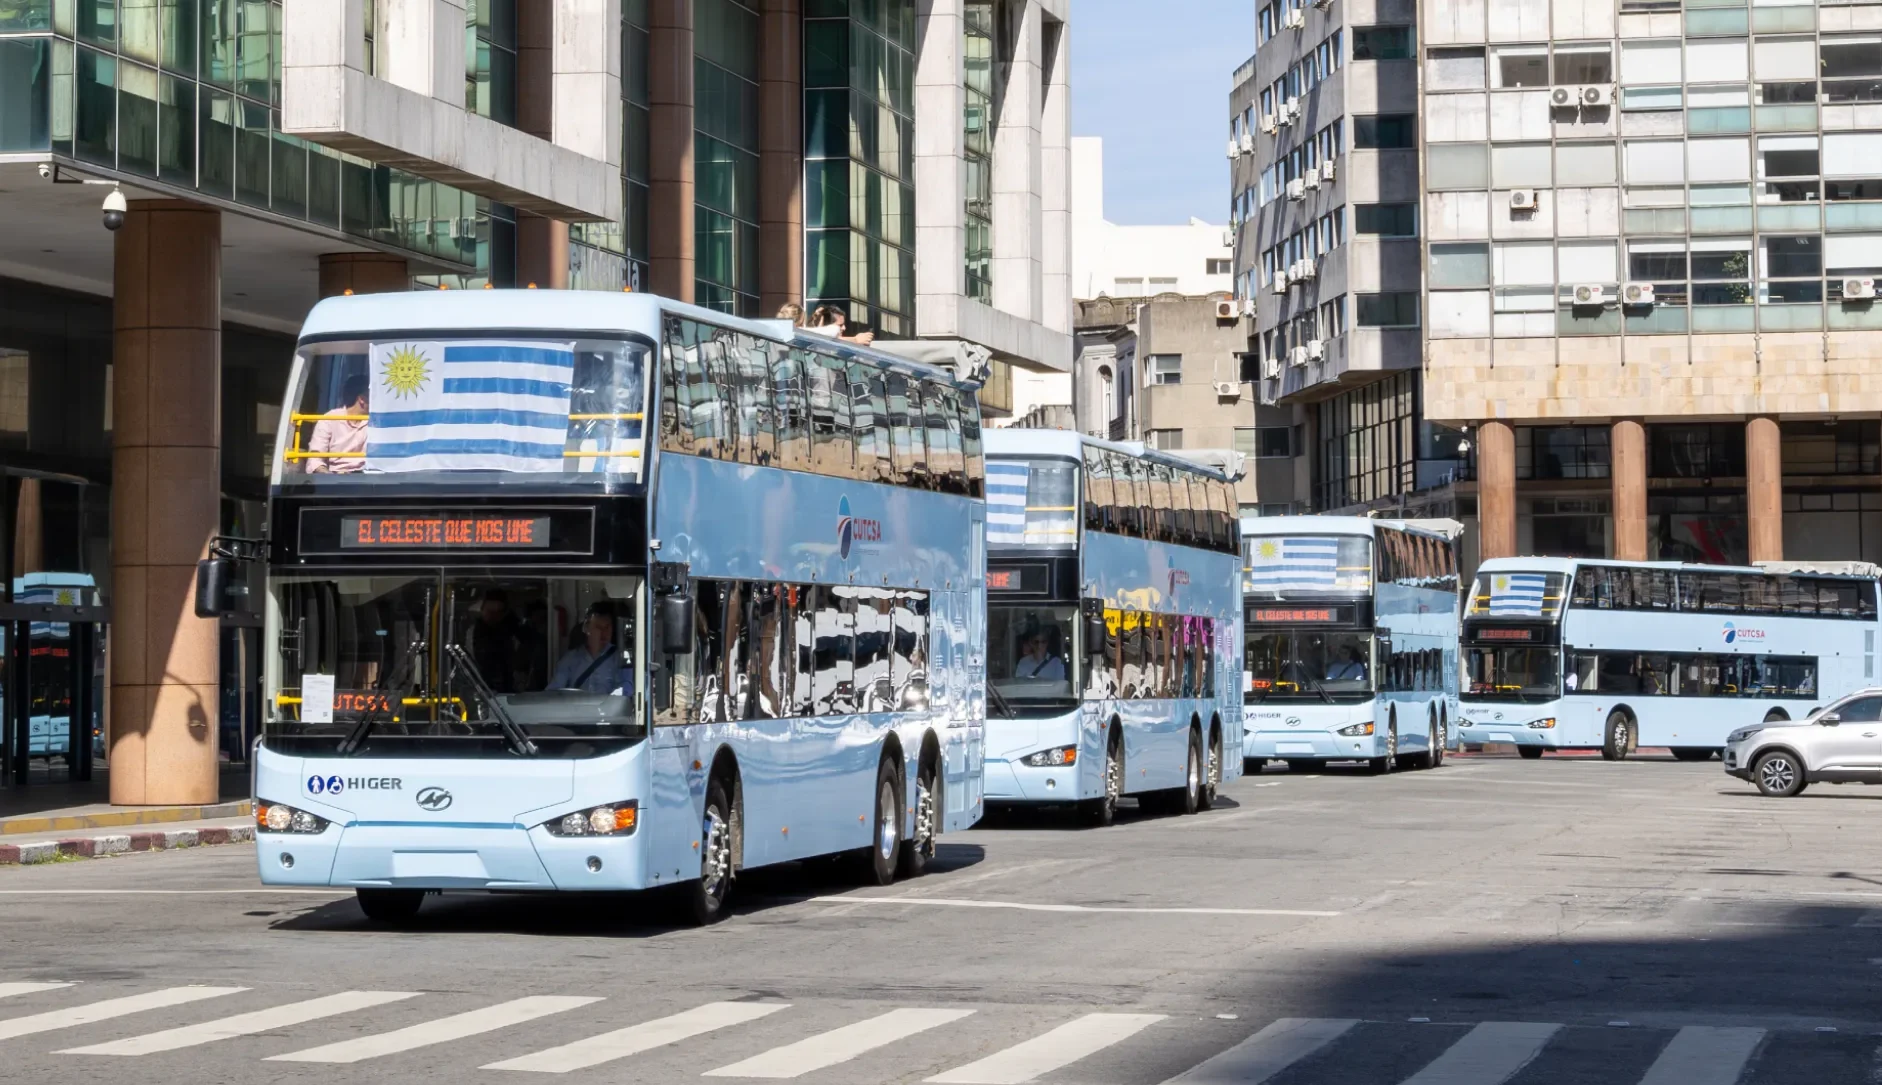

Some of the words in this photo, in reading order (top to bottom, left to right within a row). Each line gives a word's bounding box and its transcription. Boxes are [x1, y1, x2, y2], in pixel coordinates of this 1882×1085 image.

[358, 519, 376, 543] EL
[379, 519, 443, 543] CELESTE
[444, 519, 473, 543] QUE
[475, 519, 504, 543] NOS
[853, 518, 882, 541] CUTCSA
[1737, 629, 1766, 638] CUTCSA
[332, 694, 389, 712] UTCSA
[348, 777, 403, 790] HIGER
